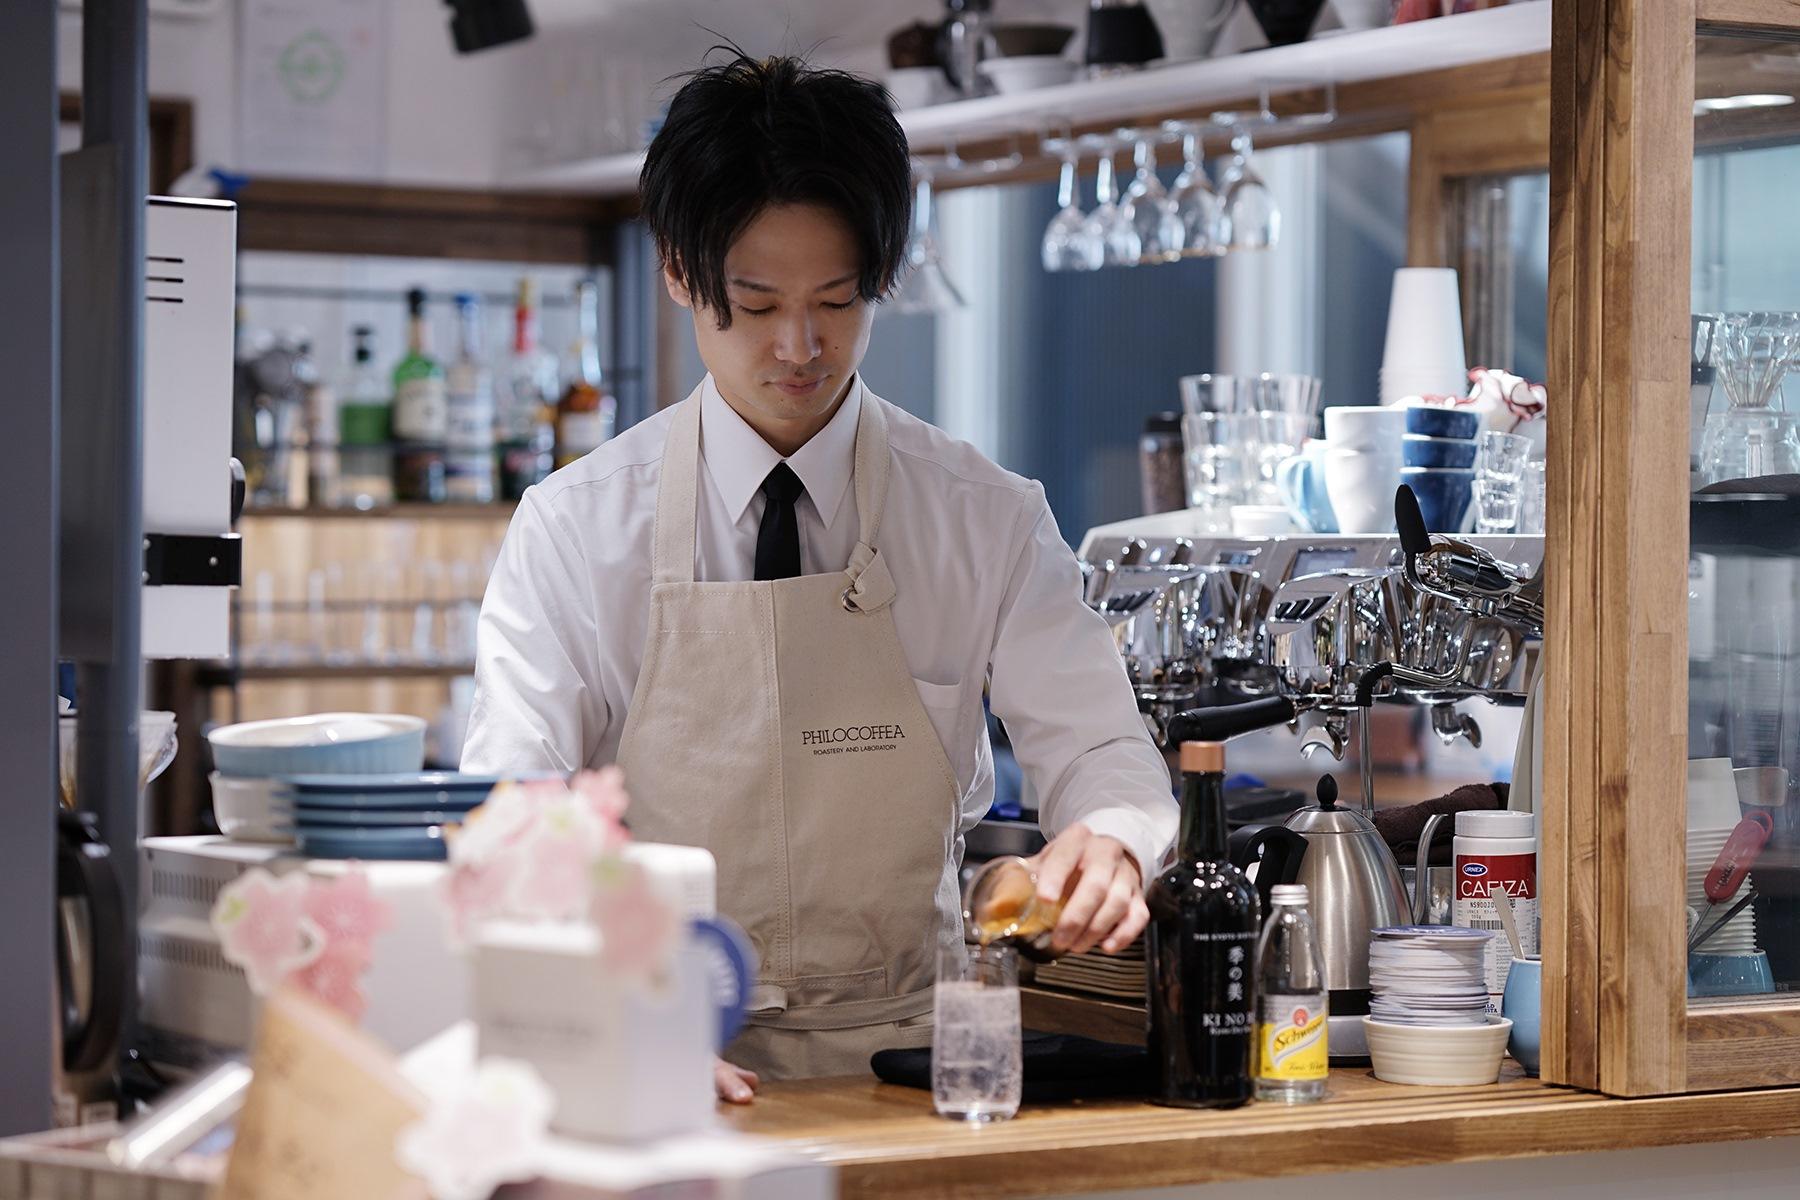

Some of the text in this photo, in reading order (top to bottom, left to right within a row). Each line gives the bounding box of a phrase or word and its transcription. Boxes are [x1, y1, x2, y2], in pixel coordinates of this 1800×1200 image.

[802, 725, 905, 745] PHILOCOFFEA
[813, 747, 843, 756] ROASTERY
[860, 744, 896, 752] LABORATORY
[1202, 1013, 1221, 1027] KI
[1224, 1012, 1246, 1026] NO
